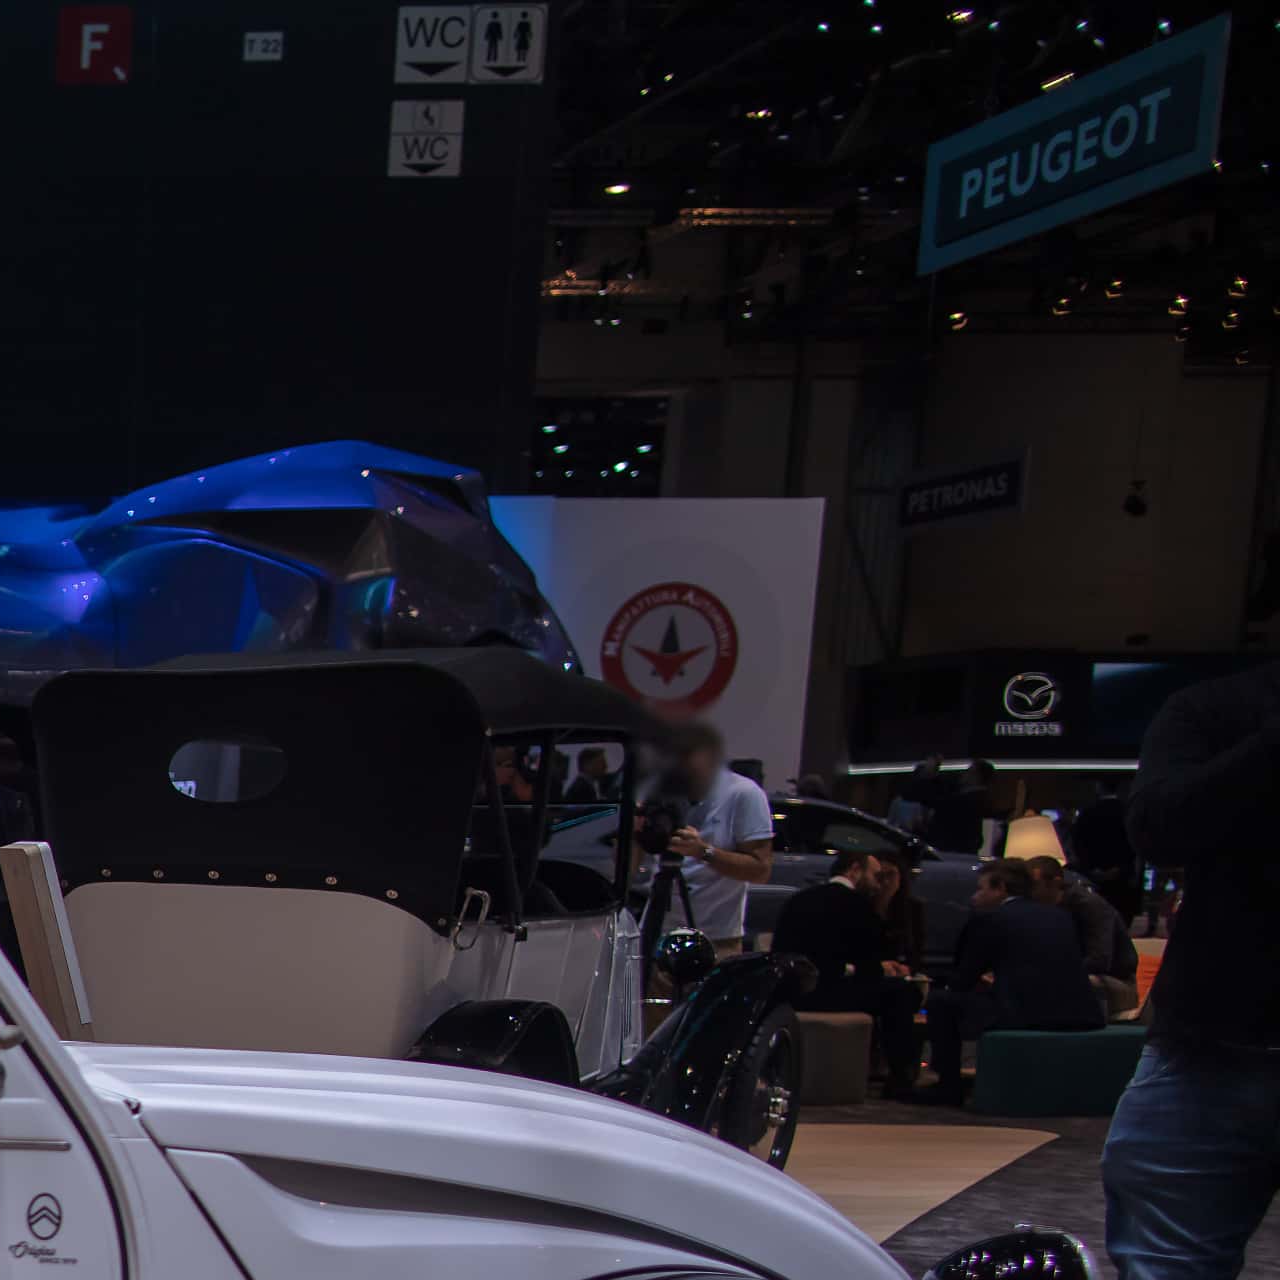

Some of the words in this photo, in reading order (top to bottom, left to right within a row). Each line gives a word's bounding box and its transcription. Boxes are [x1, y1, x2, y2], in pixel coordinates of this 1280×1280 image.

[80, 23, 110, 70] F
[404, 16, 465, 48] WC
[402, 136, 449, 161] WC
[958, 88, 1172, 219] PEUGEOT
[907, 471, 1009, 517] PETRONAS
